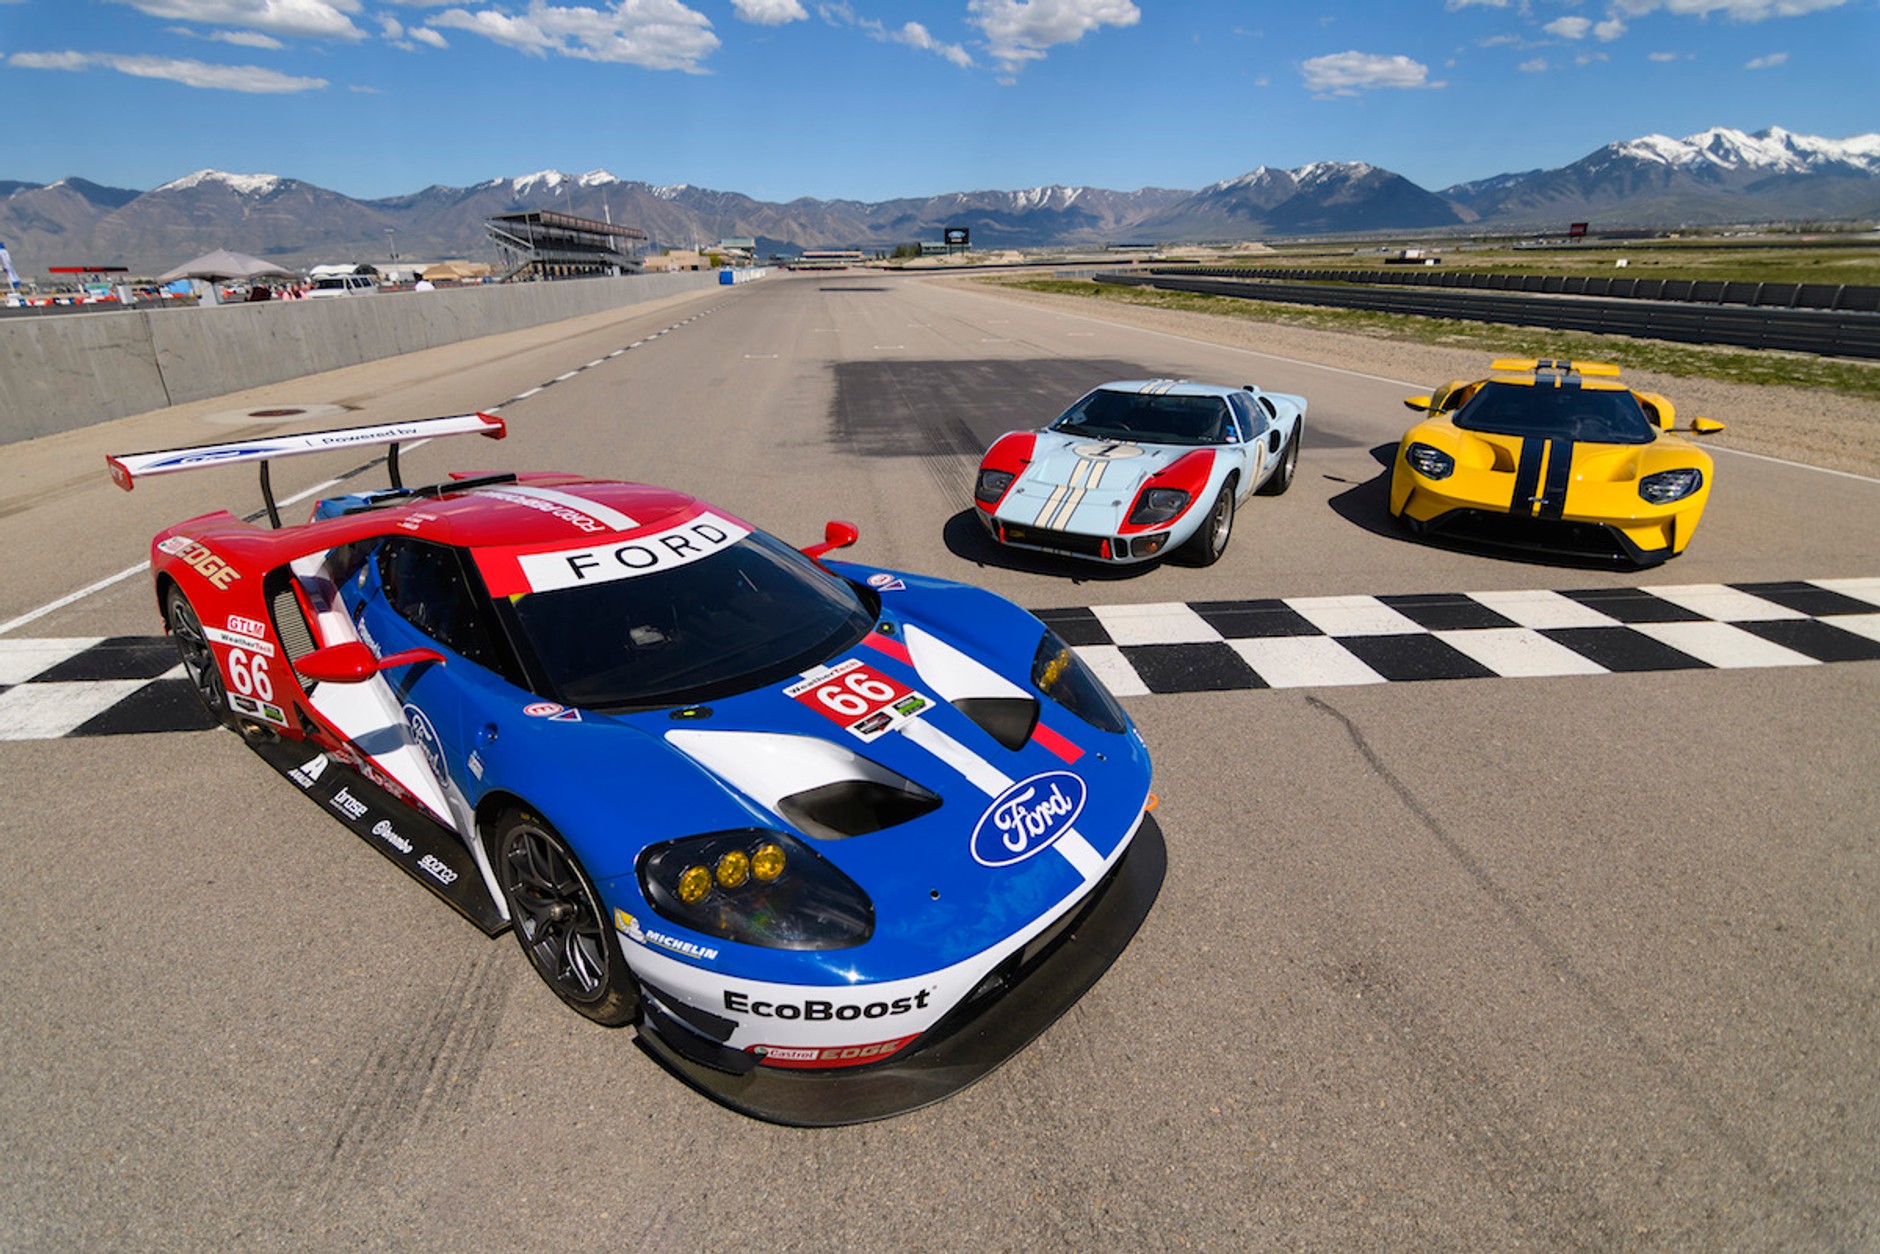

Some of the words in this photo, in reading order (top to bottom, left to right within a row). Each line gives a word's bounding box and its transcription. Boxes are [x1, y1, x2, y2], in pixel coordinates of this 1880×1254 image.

[322, 430, 396, 445] Powered
[552, 506, 606, 533] FORD
[174, 541, 243, 591] EDGE
[566, 524, 728, 580] FORD
[220, 633, 273, 653] WeatherTech
[229, 617, 265, 637] GTLM
[228, 648, 274, 702] 66
[788, 660, 860, 695] WeatherTech
[816, 672, 896, 717] 66
[412, 714, 441, 776] Ford
[333, 786, 369, 819] brose
[993, 782, 1073, 853] Ford
[418, 853, 459, 883] sparco
[645, 929, 719, 960] MICHELIN
[723, 987, 931, 1022] EcoBoost
[769, 1048, 815, 1060] Castrol
[819, 1039, 901, 1060] EDGE
